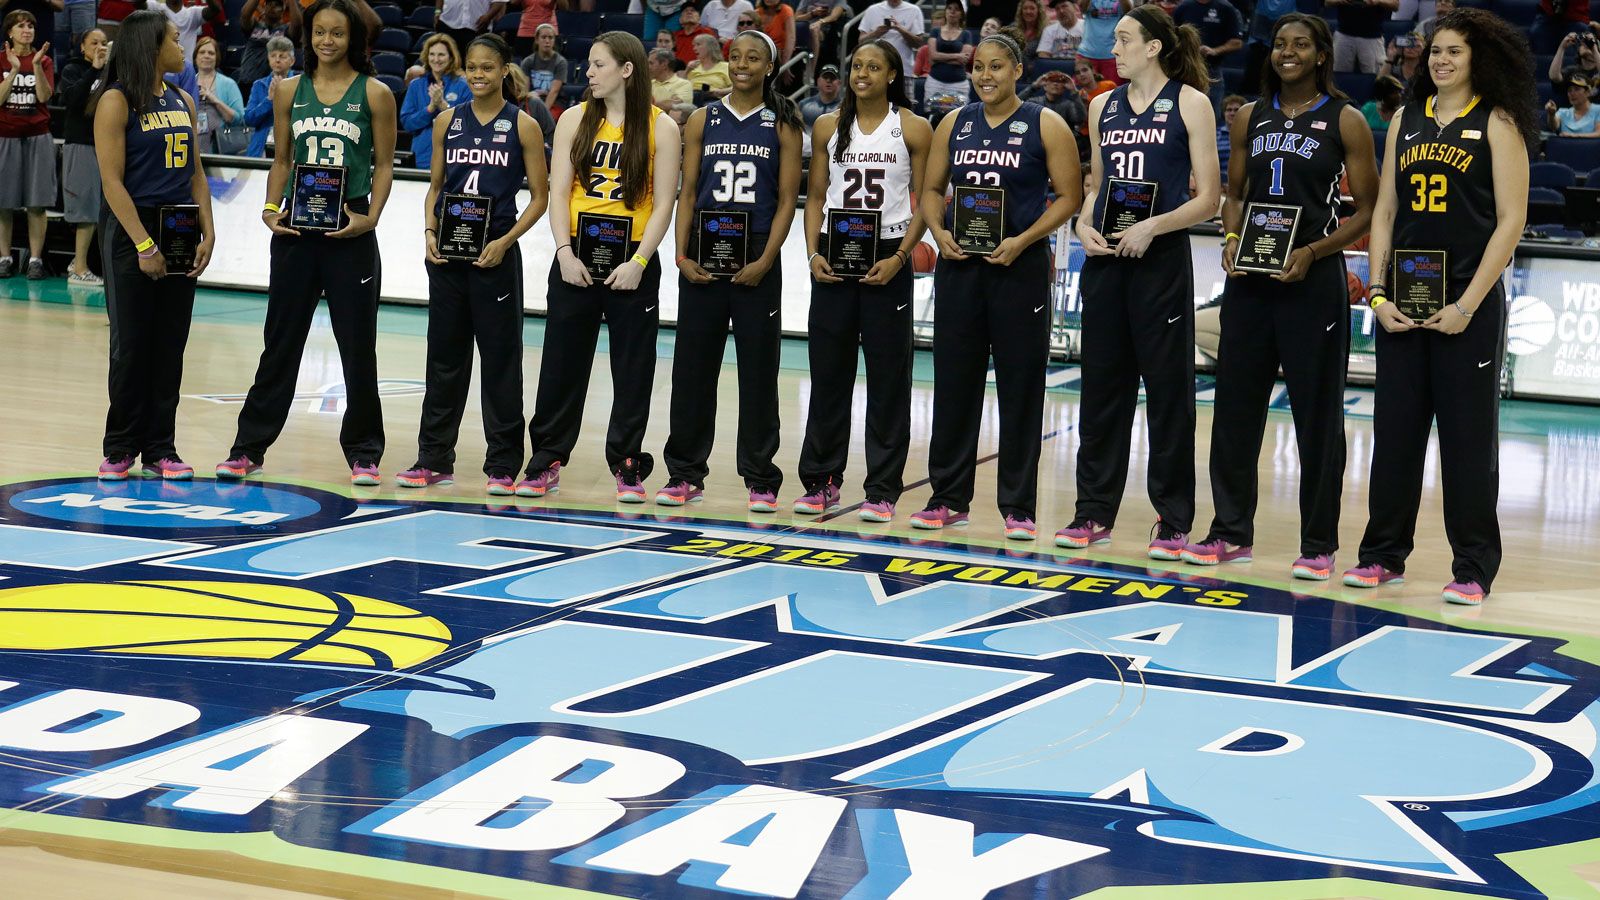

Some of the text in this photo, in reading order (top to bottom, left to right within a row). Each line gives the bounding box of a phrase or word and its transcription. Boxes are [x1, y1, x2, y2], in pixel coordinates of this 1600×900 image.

[292, 116, 361, 144] BAYLOR
[1101, 129, 1166, 147] UCONN
[164, 133, 189, 169] 15
[305, 136, 345, 166] 13
[446, 148, 509, 167] UCONN
[591, 140, 625, 169] OW
[704, 143, 770, 159] NOTRE DAME
[832, 152, 897, 164] SUTH CAROLINA
[953, 149, 1020, 169] UCONN
[1252, 133, 1320, 159] DUKE
[1400, 143, 1473, 173] MINNESOTA
[1110, 150, 1144, 180] 30
[1269, 157, 1284, 196] 1
[463, 169, 480, 195] 4
[712, 160, 757, 204] 32
[843, 168, 886, 210] 25
[1410, 173, 1447, 213] 32
[1558, 311, 1600, 344] CO
[22, 493, 290, 525] NCAA
[667, 537, 1250, 608] 2015 WOMEN'S
[138, 509, 1573, 715] FINAL
[371, 735, 1111, 900] BAY
